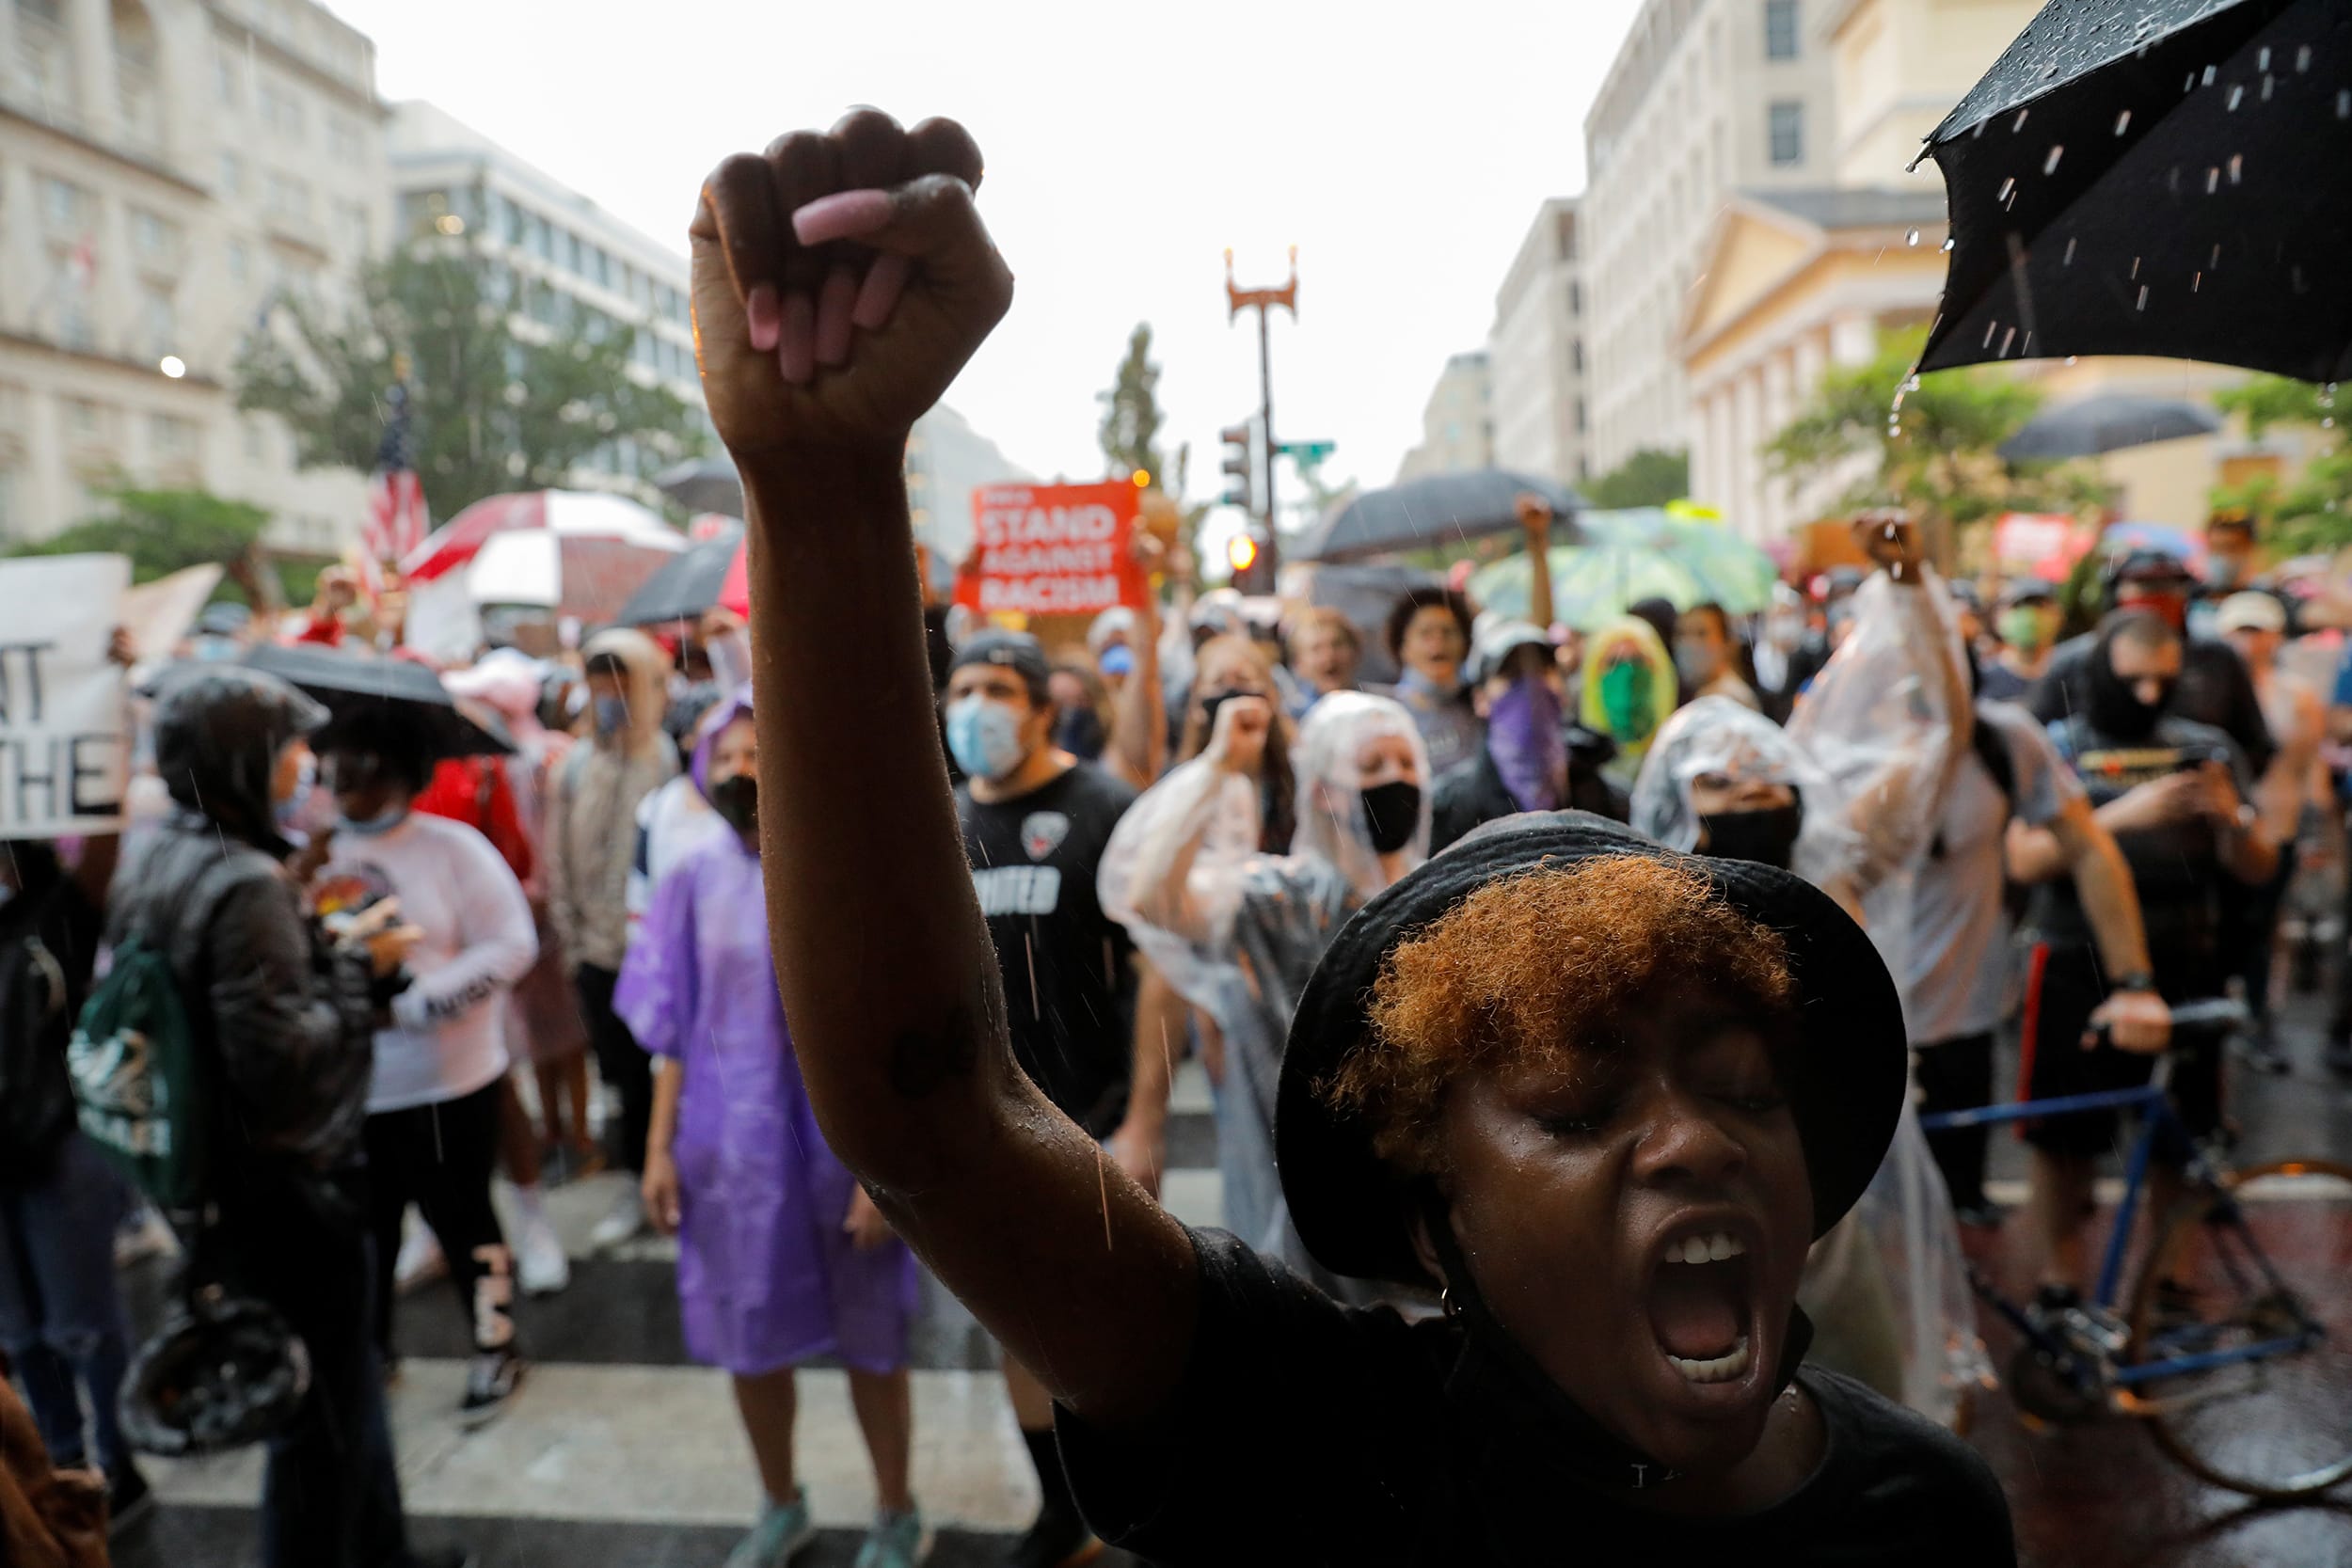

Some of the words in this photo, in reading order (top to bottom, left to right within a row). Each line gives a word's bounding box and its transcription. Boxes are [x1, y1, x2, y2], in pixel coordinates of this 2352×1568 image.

[980, 504, 1117, 546] STAND
[980, 543, 1116, 575] AGAINST
[979, 574, 1120, 611] RACISM
[0, 641, 56, 725] T
